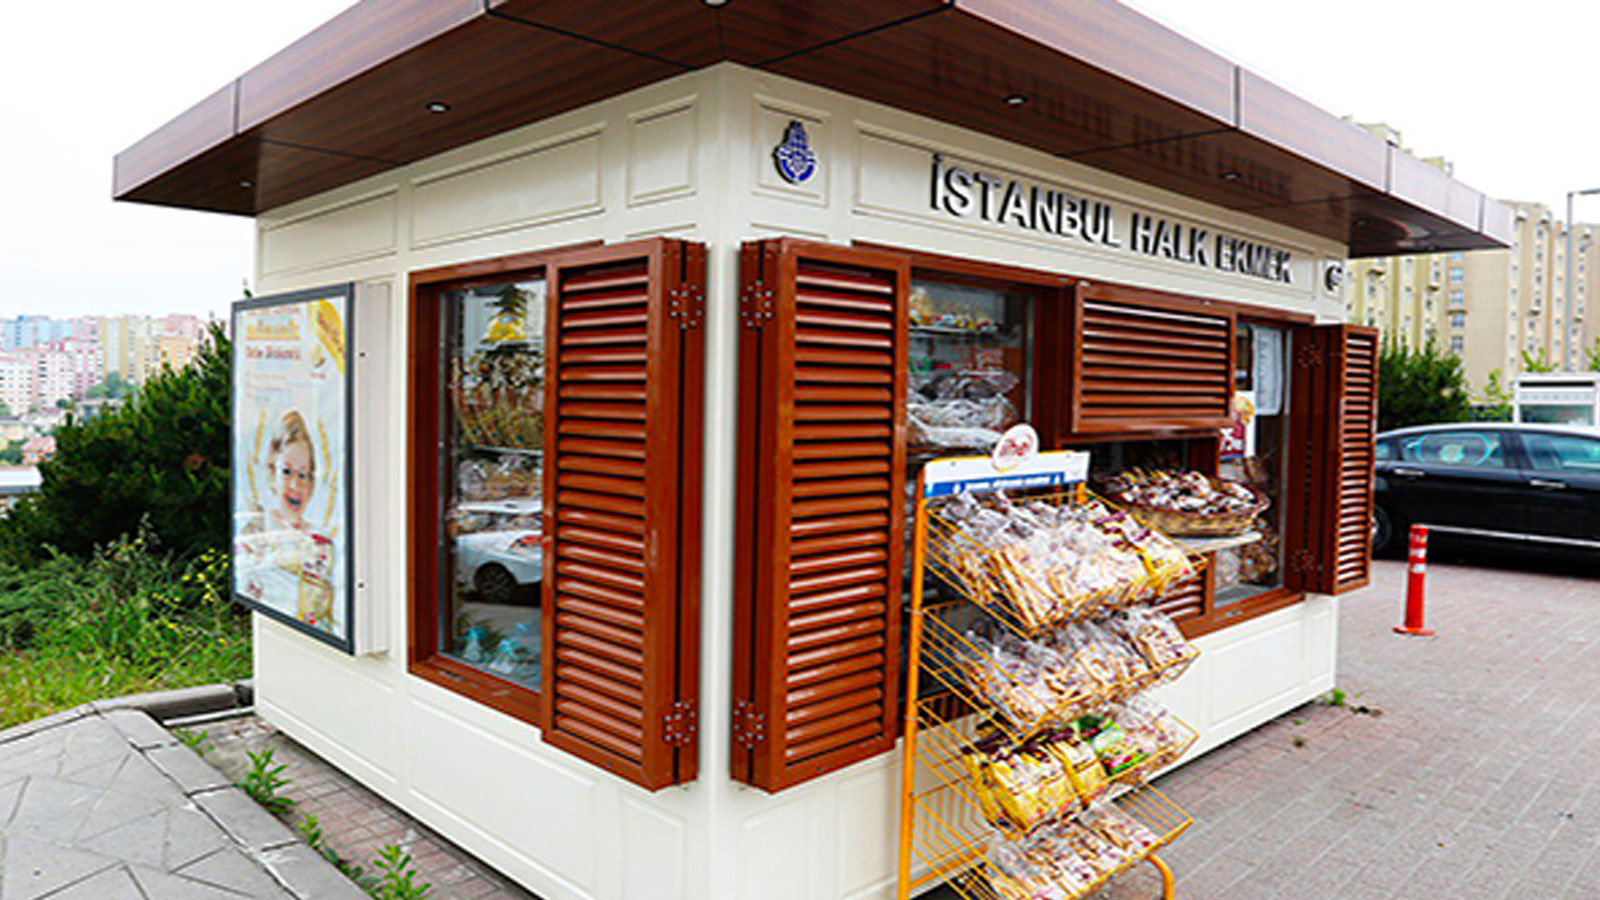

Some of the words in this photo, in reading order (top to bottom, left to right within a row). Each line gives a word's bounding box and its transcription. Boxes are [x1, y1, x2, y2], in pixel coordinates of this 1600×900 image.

[930, 153, 1121, 248] İSTANBUL
[1130, 212, 1209, 267] HALK
[1215, 234, 1292, 283] EKMEK
